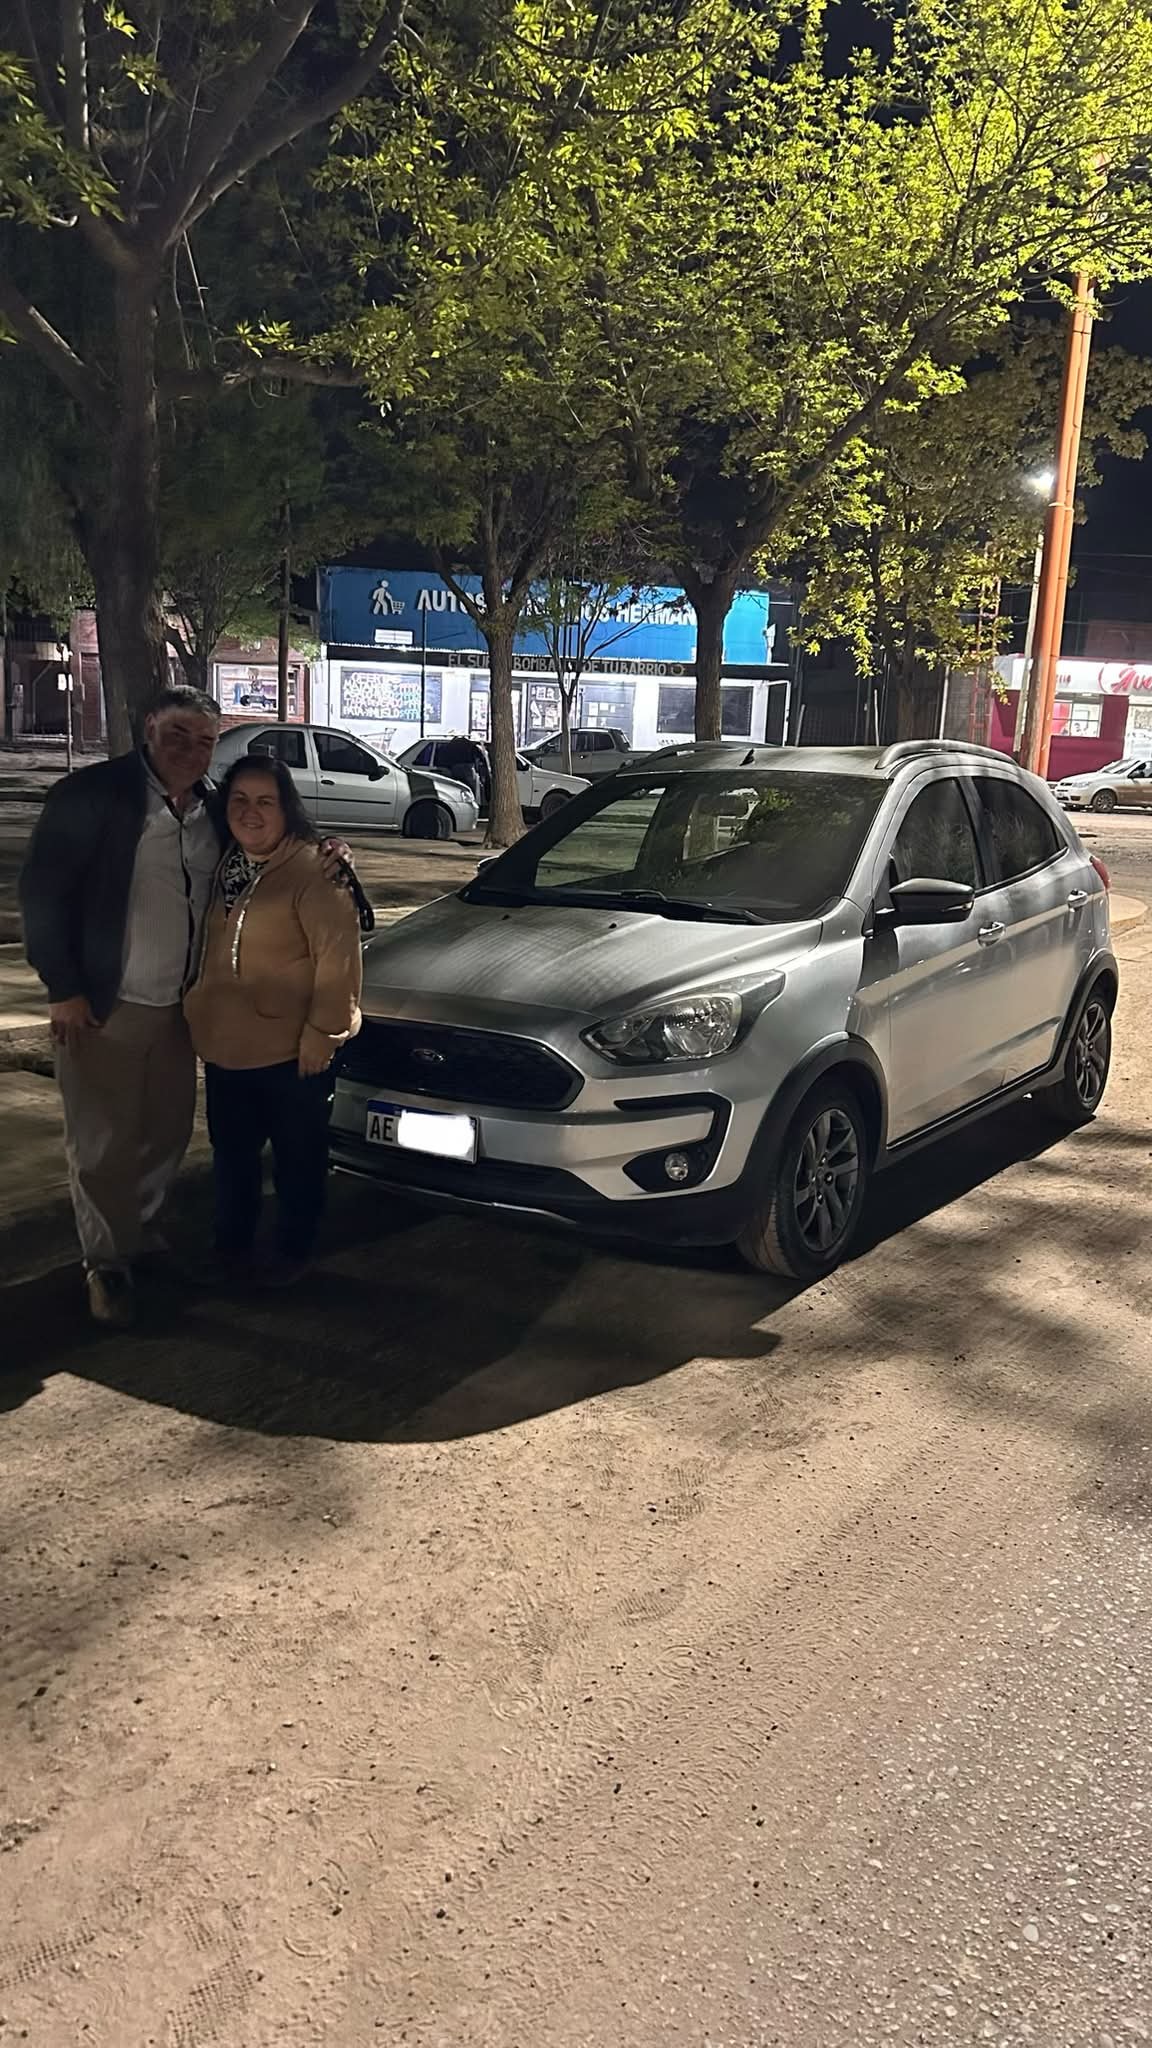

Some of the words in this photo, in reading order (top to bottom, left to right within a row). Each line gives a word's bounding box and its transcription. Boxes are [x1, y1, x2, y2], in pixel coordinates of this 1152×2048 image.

[615, 601, 699, 626] HERMAN
[448, 653, 467, 668] EL
[583, 660, 601, 673] DE
[602, 660, 620, 674] TU
[620, 662, 667, 676] BARRIO
